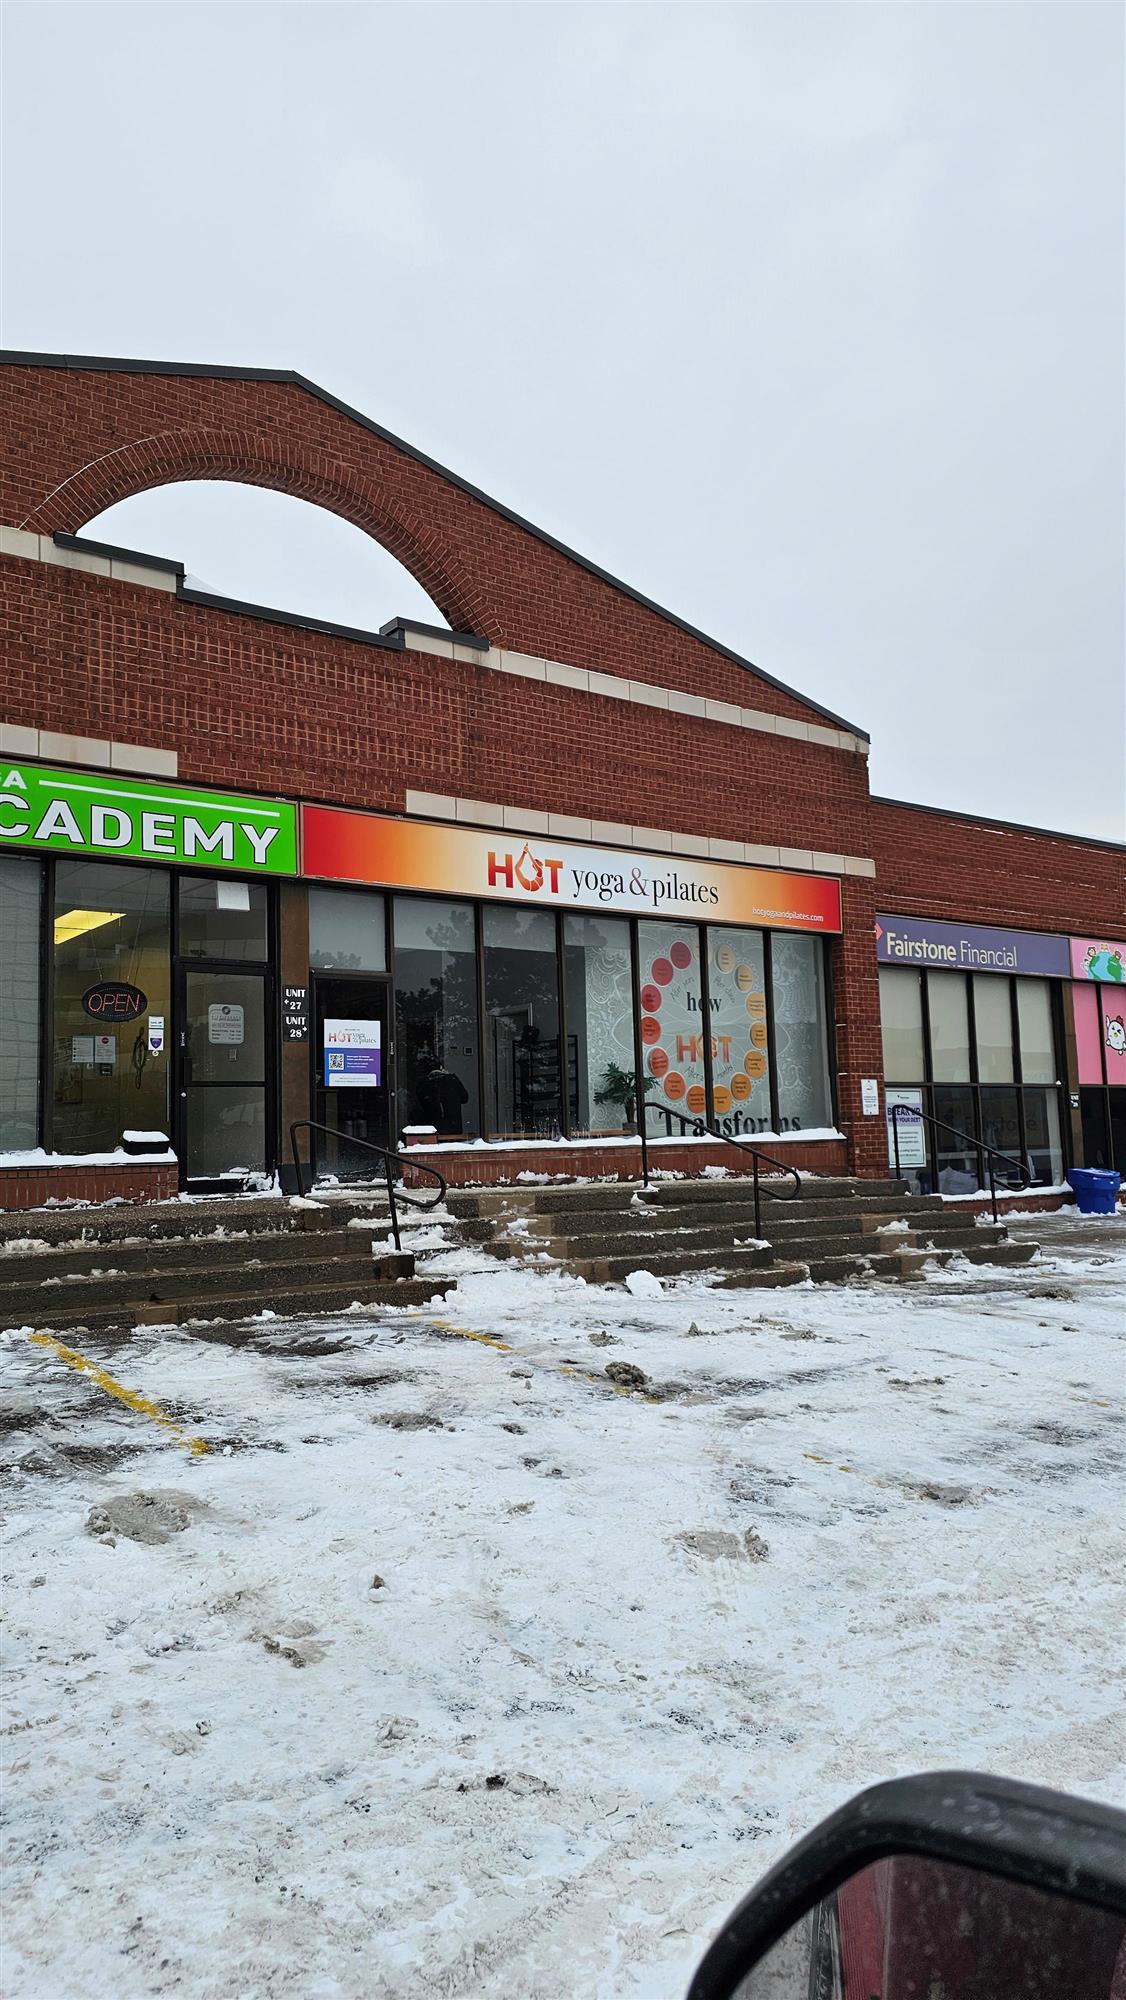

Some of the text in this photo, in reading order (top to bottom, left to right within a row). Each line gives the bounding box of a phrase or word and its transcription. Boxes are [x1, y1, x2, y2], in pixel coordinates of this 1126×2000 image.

[0, 769, 27, 790] A
[0, 792, 280, 864] CADEMY
[487, 843, 563, 893] HOT
[571, 869, 625, 901] yoga
[652, 872, 719, 906] pilates
[752, 906, 824, 922] hotyogaandpilates.com
[886, 932, 1017, 967] Fairstone Financial
[286, 989, 306, 997] UNIT
[88, 993, 140, 1012] OPEN
[290, 1001, 301, 1010] 27
[286, 1017, 306, 1025] UNIT
[290, 1029, 302, 1037] 28
[328, 1031, 352, 1043] HOT
[887, 1107, 911, 1116] BEAK
